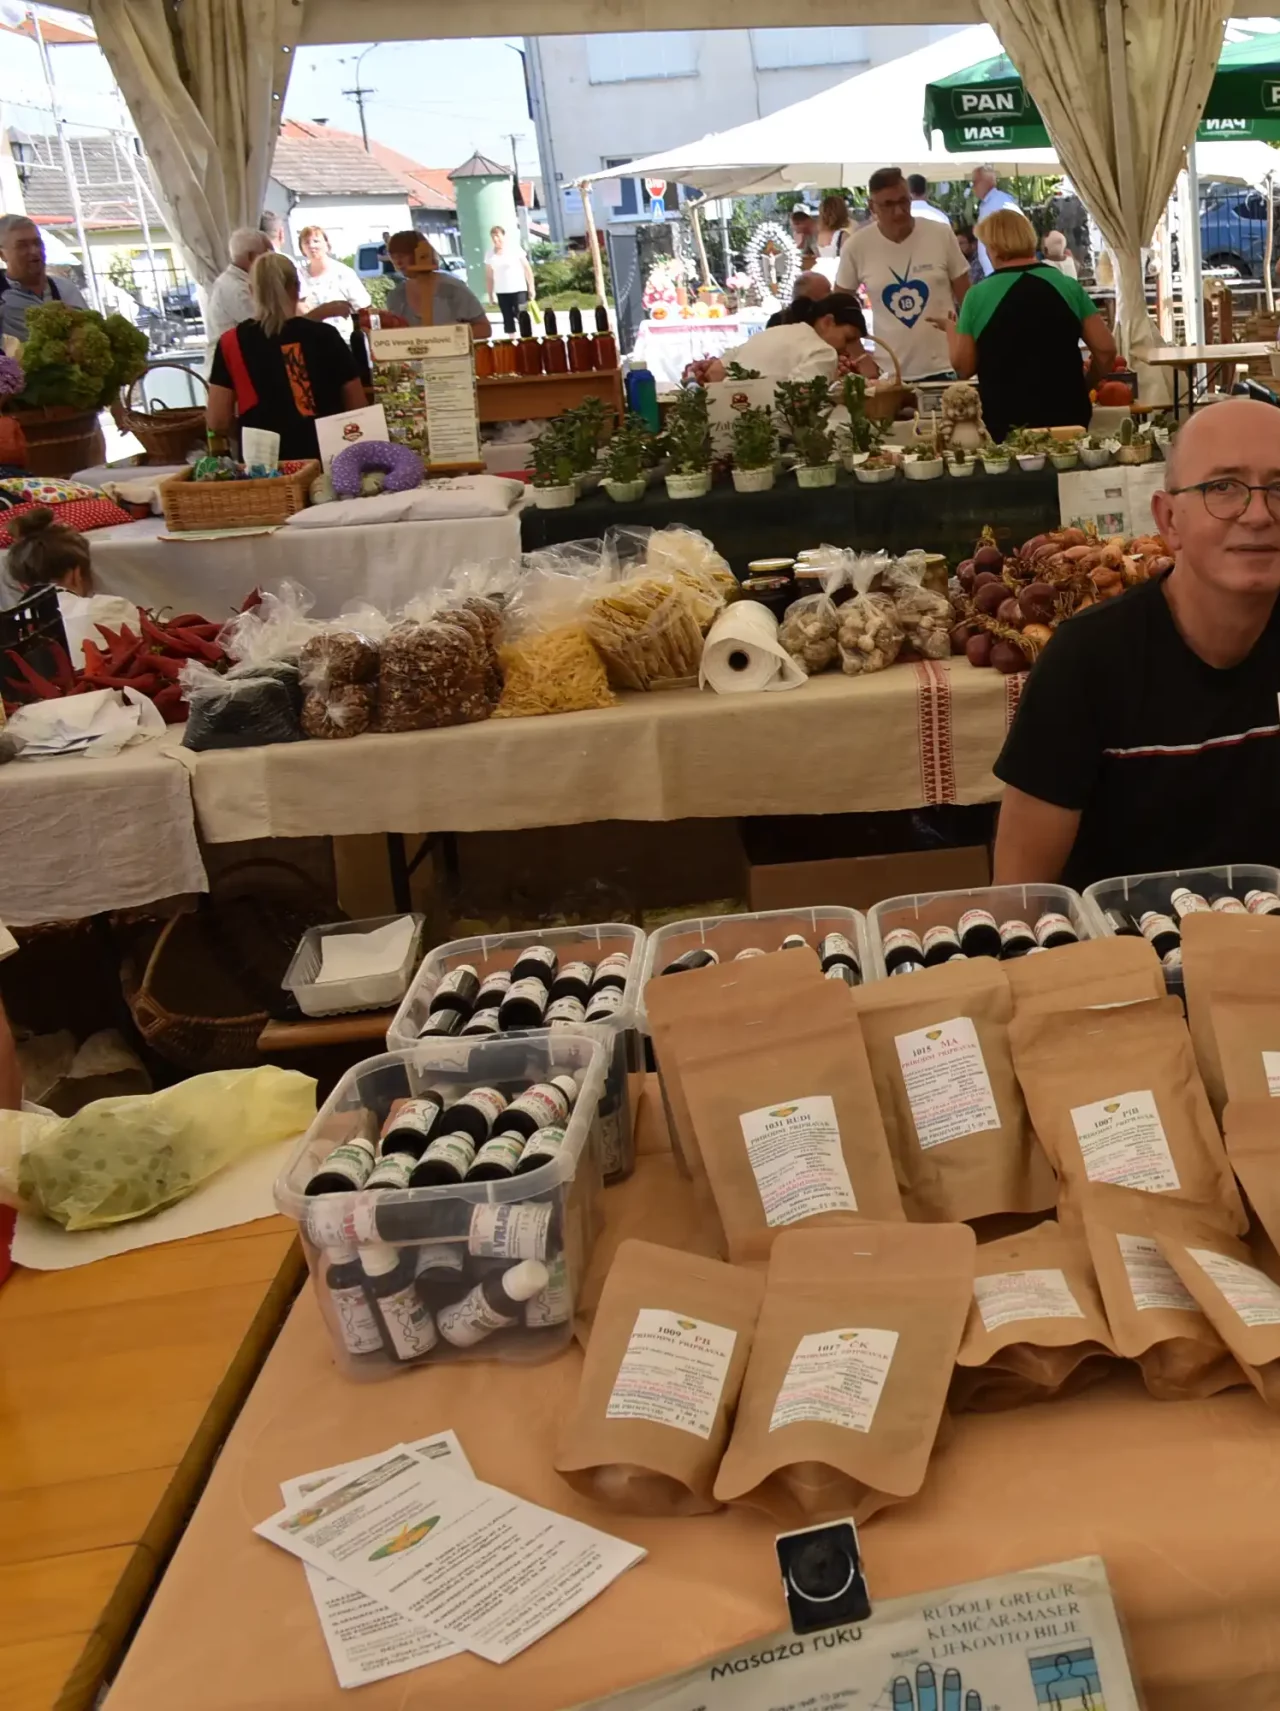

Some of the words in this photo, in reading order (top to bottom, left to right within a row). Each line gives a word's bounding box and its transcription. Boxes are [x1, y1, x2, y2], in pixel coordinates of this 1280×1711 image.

[961, 93, 1014, 111] PAN
[912, 1045, 932, 1057] 1015
[765, 1119, 783, 1131] 1031
[786, 1114, 811, 1125] RUDI
[658, 1326, 682, 1338] 1009
[921, 1596, 995, 1622] RUDOLF
[998, 1583, 1076, 1609] GREGUR
[931, 1632, 1030, 1660] LJEKOVITO
[1033, 1620, 1080, 1641] BILJE
[709, 1641, 805, 1682] Masaža
[813, 1626, 863, 1652] ruku
